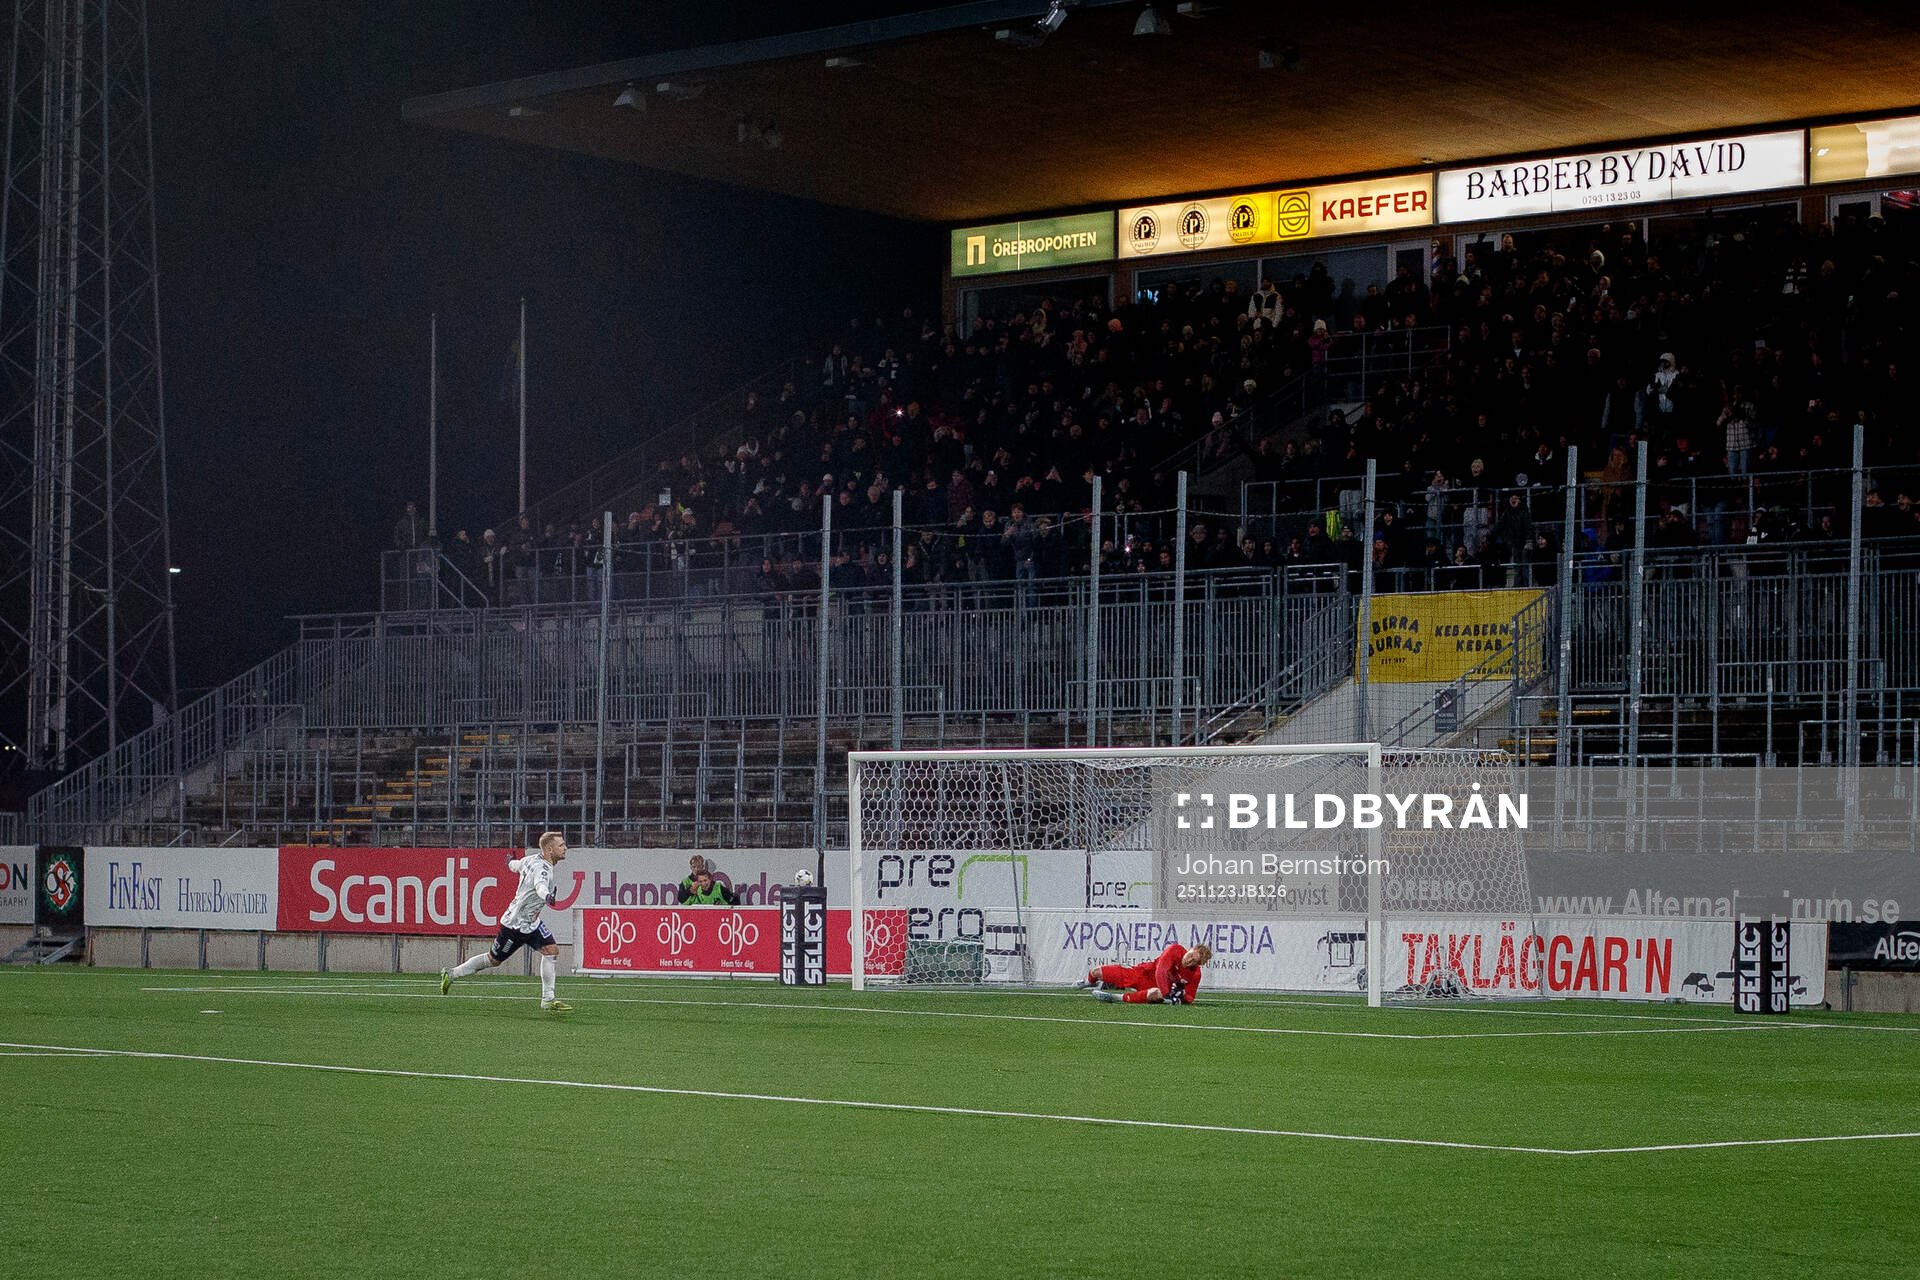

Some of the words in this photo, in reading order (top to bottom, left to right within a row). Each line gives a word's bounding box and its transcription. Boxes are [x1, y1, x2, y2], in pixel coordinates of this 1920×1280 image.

[1466, 158, 1592, 200] BARBER
[1600, 150, 1645, 185] BY
[1648, 142, 1746, 181] DAVID
[1322, 190, 1427, 222] KAEFER
[1605, 194, 1616, 202] 13
[1617, 192, 1629, 201] 23
[1630, 191, 1641, 200] 03
[992, 231, 1097, 257] ÖREBROPORTEN
[1372, 615, 1419, 635] BERRA
[1456, 639, 1502, 652] KEBAB
[309, 857, 498, 926] Scandic
[597, 912, 637, 954] ÖBO
[656, 912, 697, 955] ÖBO
[718, 912, 759, 956] ÖBO
[783, 902, 796, 985] SELECT
[804, 902, 823, 985] SELECT
[1062, 921, 1178, 952] XPONERA
[1190, 923, 1275, 954] MEDIA
[1874, 935, 1920, 960] Alte
[1401, 922, 1672, 993] TAKLÄGGAR'N
[1739, 913, 1761, 1012] SELECT
[1771, 914, 1787, 1012] SELECT
